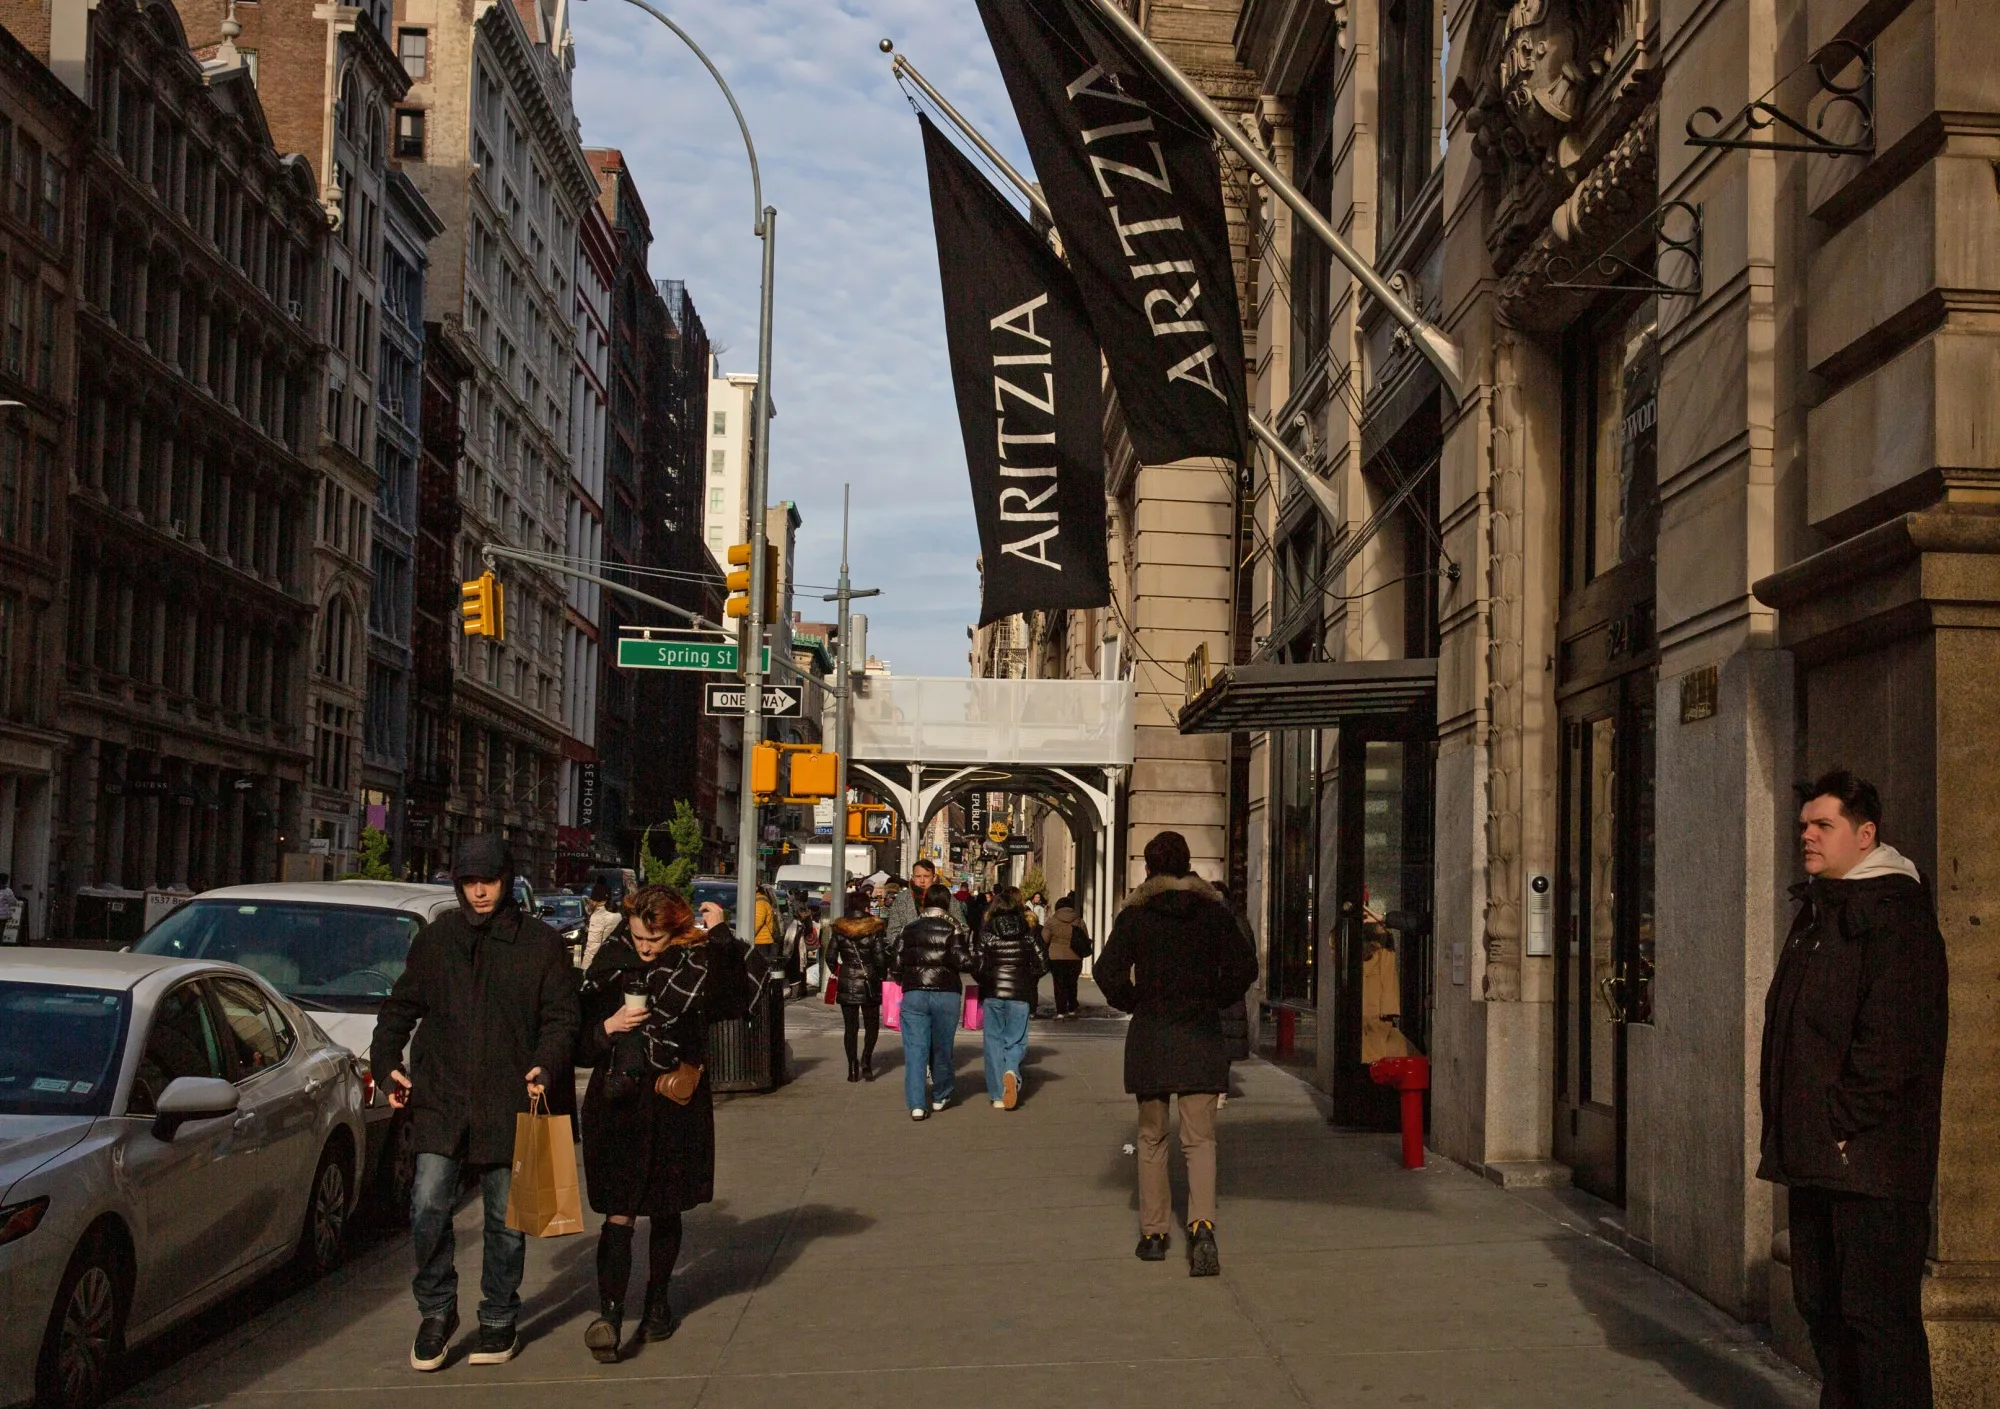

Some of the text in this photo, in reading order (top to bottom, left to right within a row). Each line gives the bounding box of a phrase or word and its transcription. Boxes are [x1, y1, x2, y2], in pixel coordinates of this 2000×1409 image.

[1066, 63, 1228, 405] ARITZIA
[990, 291, 1062, 572] ARITZIA
[658, 647, 732, 667] Spring St
[720, 693, 787, 707] ONE WAY
[134, 781, 168, 789] GUESS
[583, 763, 594, 825] SEPHORA
[971, 793, 980, 831] EPUBLIC
